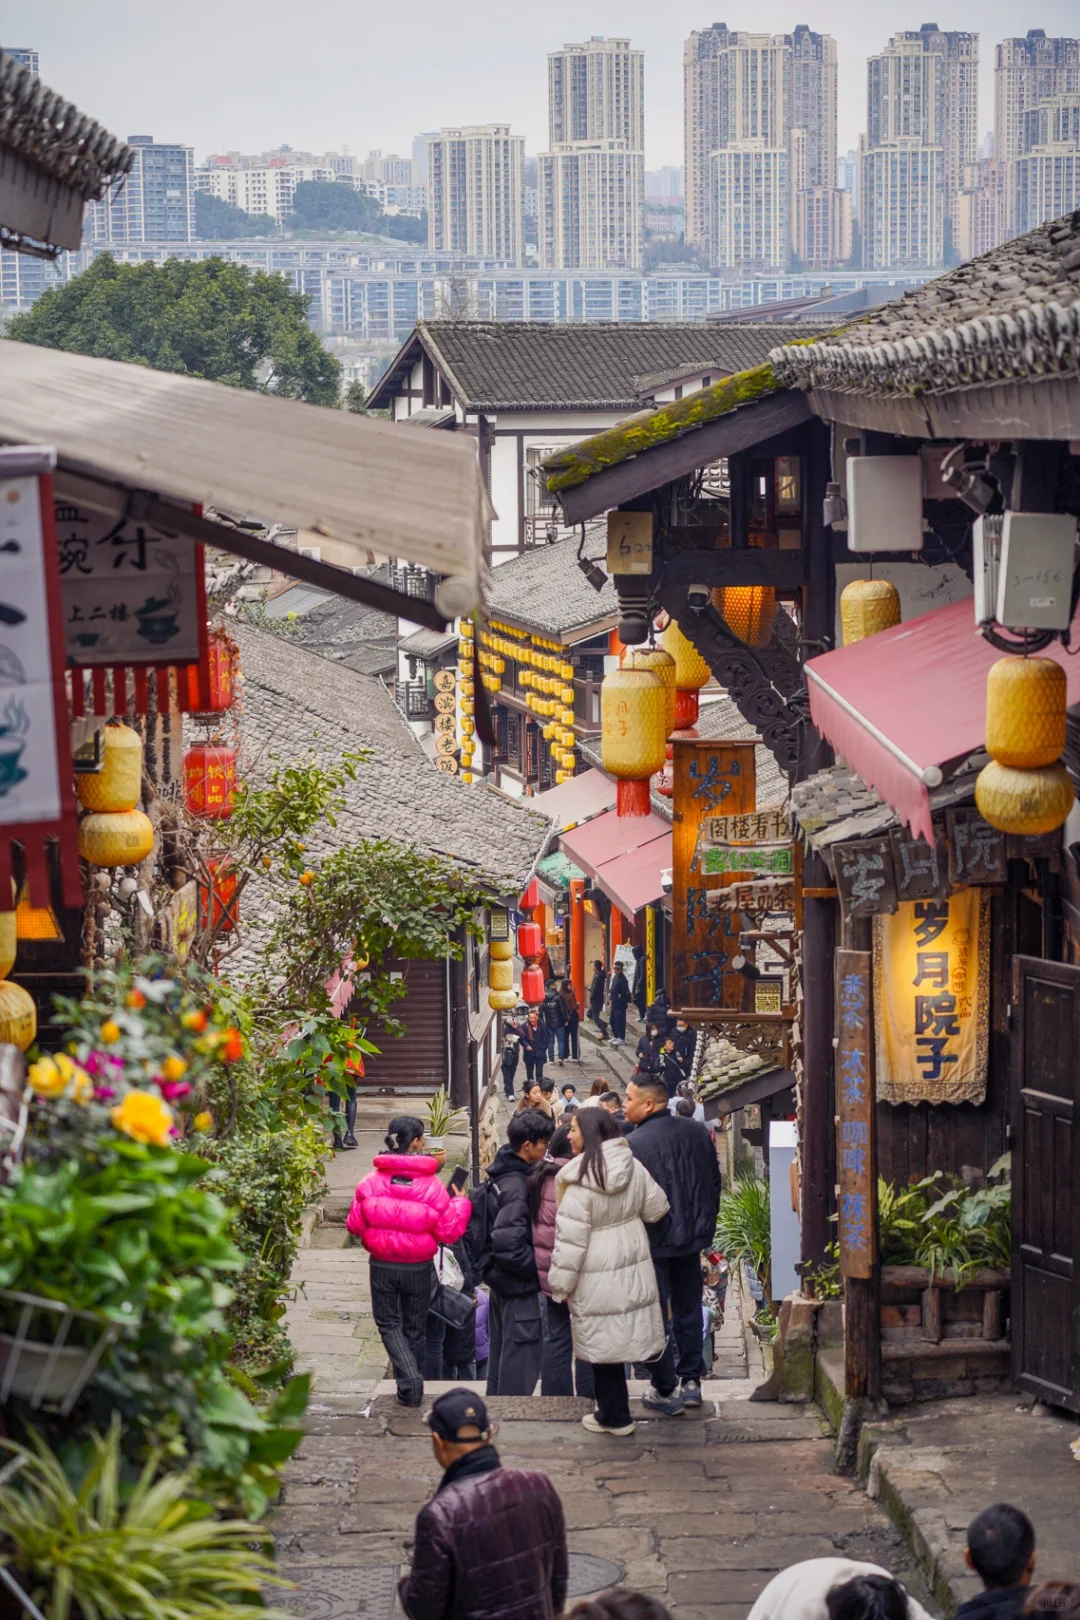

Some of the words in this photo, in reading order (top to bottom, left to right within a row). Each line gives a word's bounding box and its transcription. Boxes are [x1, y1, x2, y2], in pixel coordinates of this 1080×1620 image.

[207, 764, 225, 804] 饮品
[710, 811, 790, 840] 阁楼看书
[704, 847, 792, 873] 露台花园
[912, 900, 961, 1080] 岁月院子
[842, 1120, 869, 1177] 咖啡
